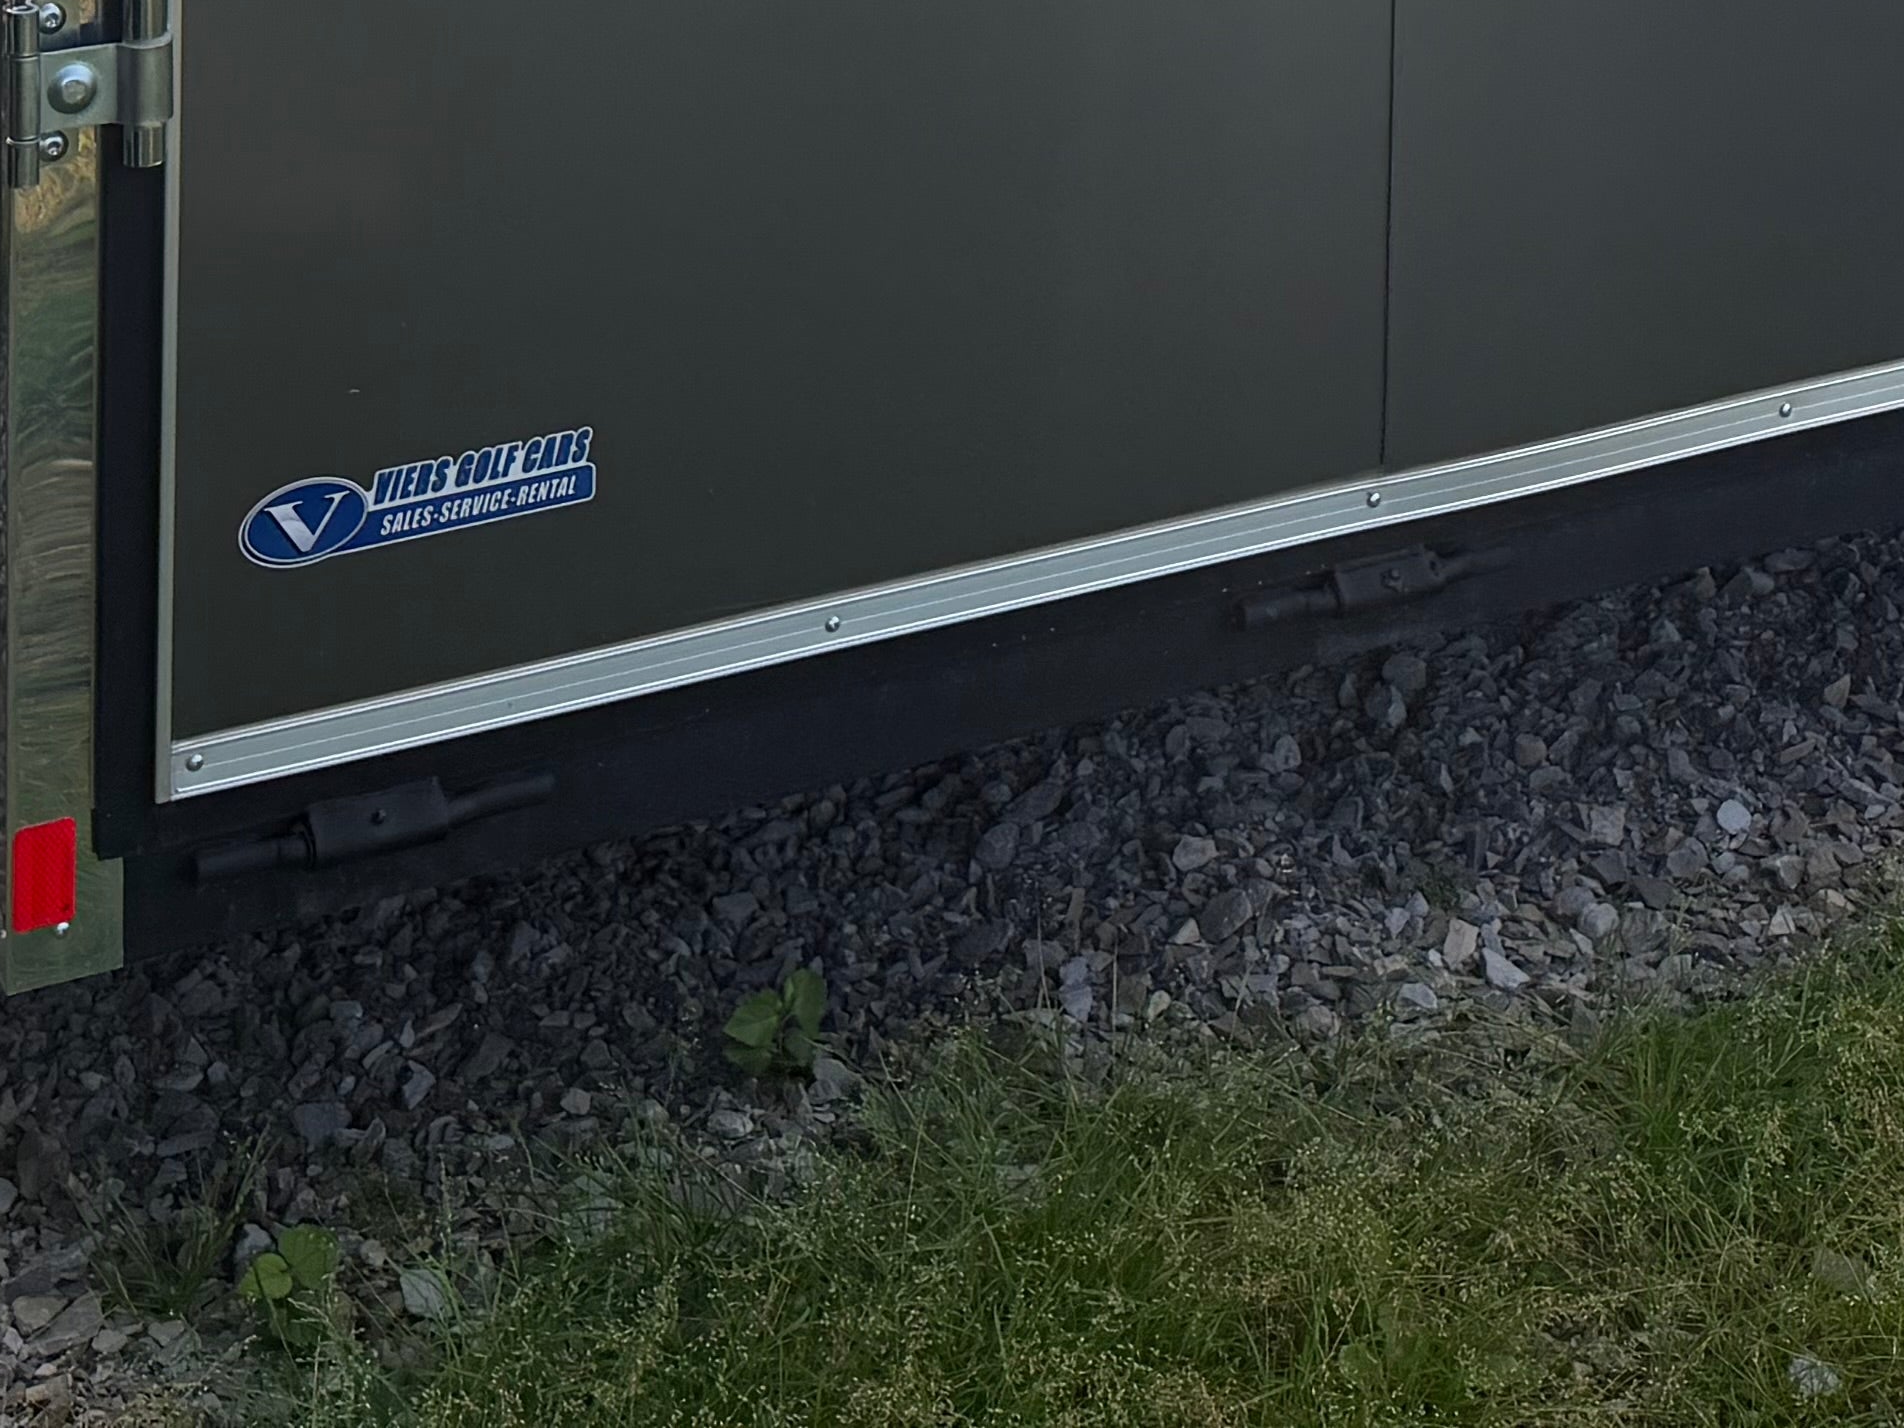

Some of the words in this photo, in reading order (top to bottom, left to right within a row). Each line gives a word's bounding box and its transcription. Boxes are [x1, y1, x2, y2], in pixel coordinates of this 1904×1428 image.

[454, 442, 521, 488] GOLF
[521, 428, 592, 473] CARS
[263, 490, 351, 554] V
